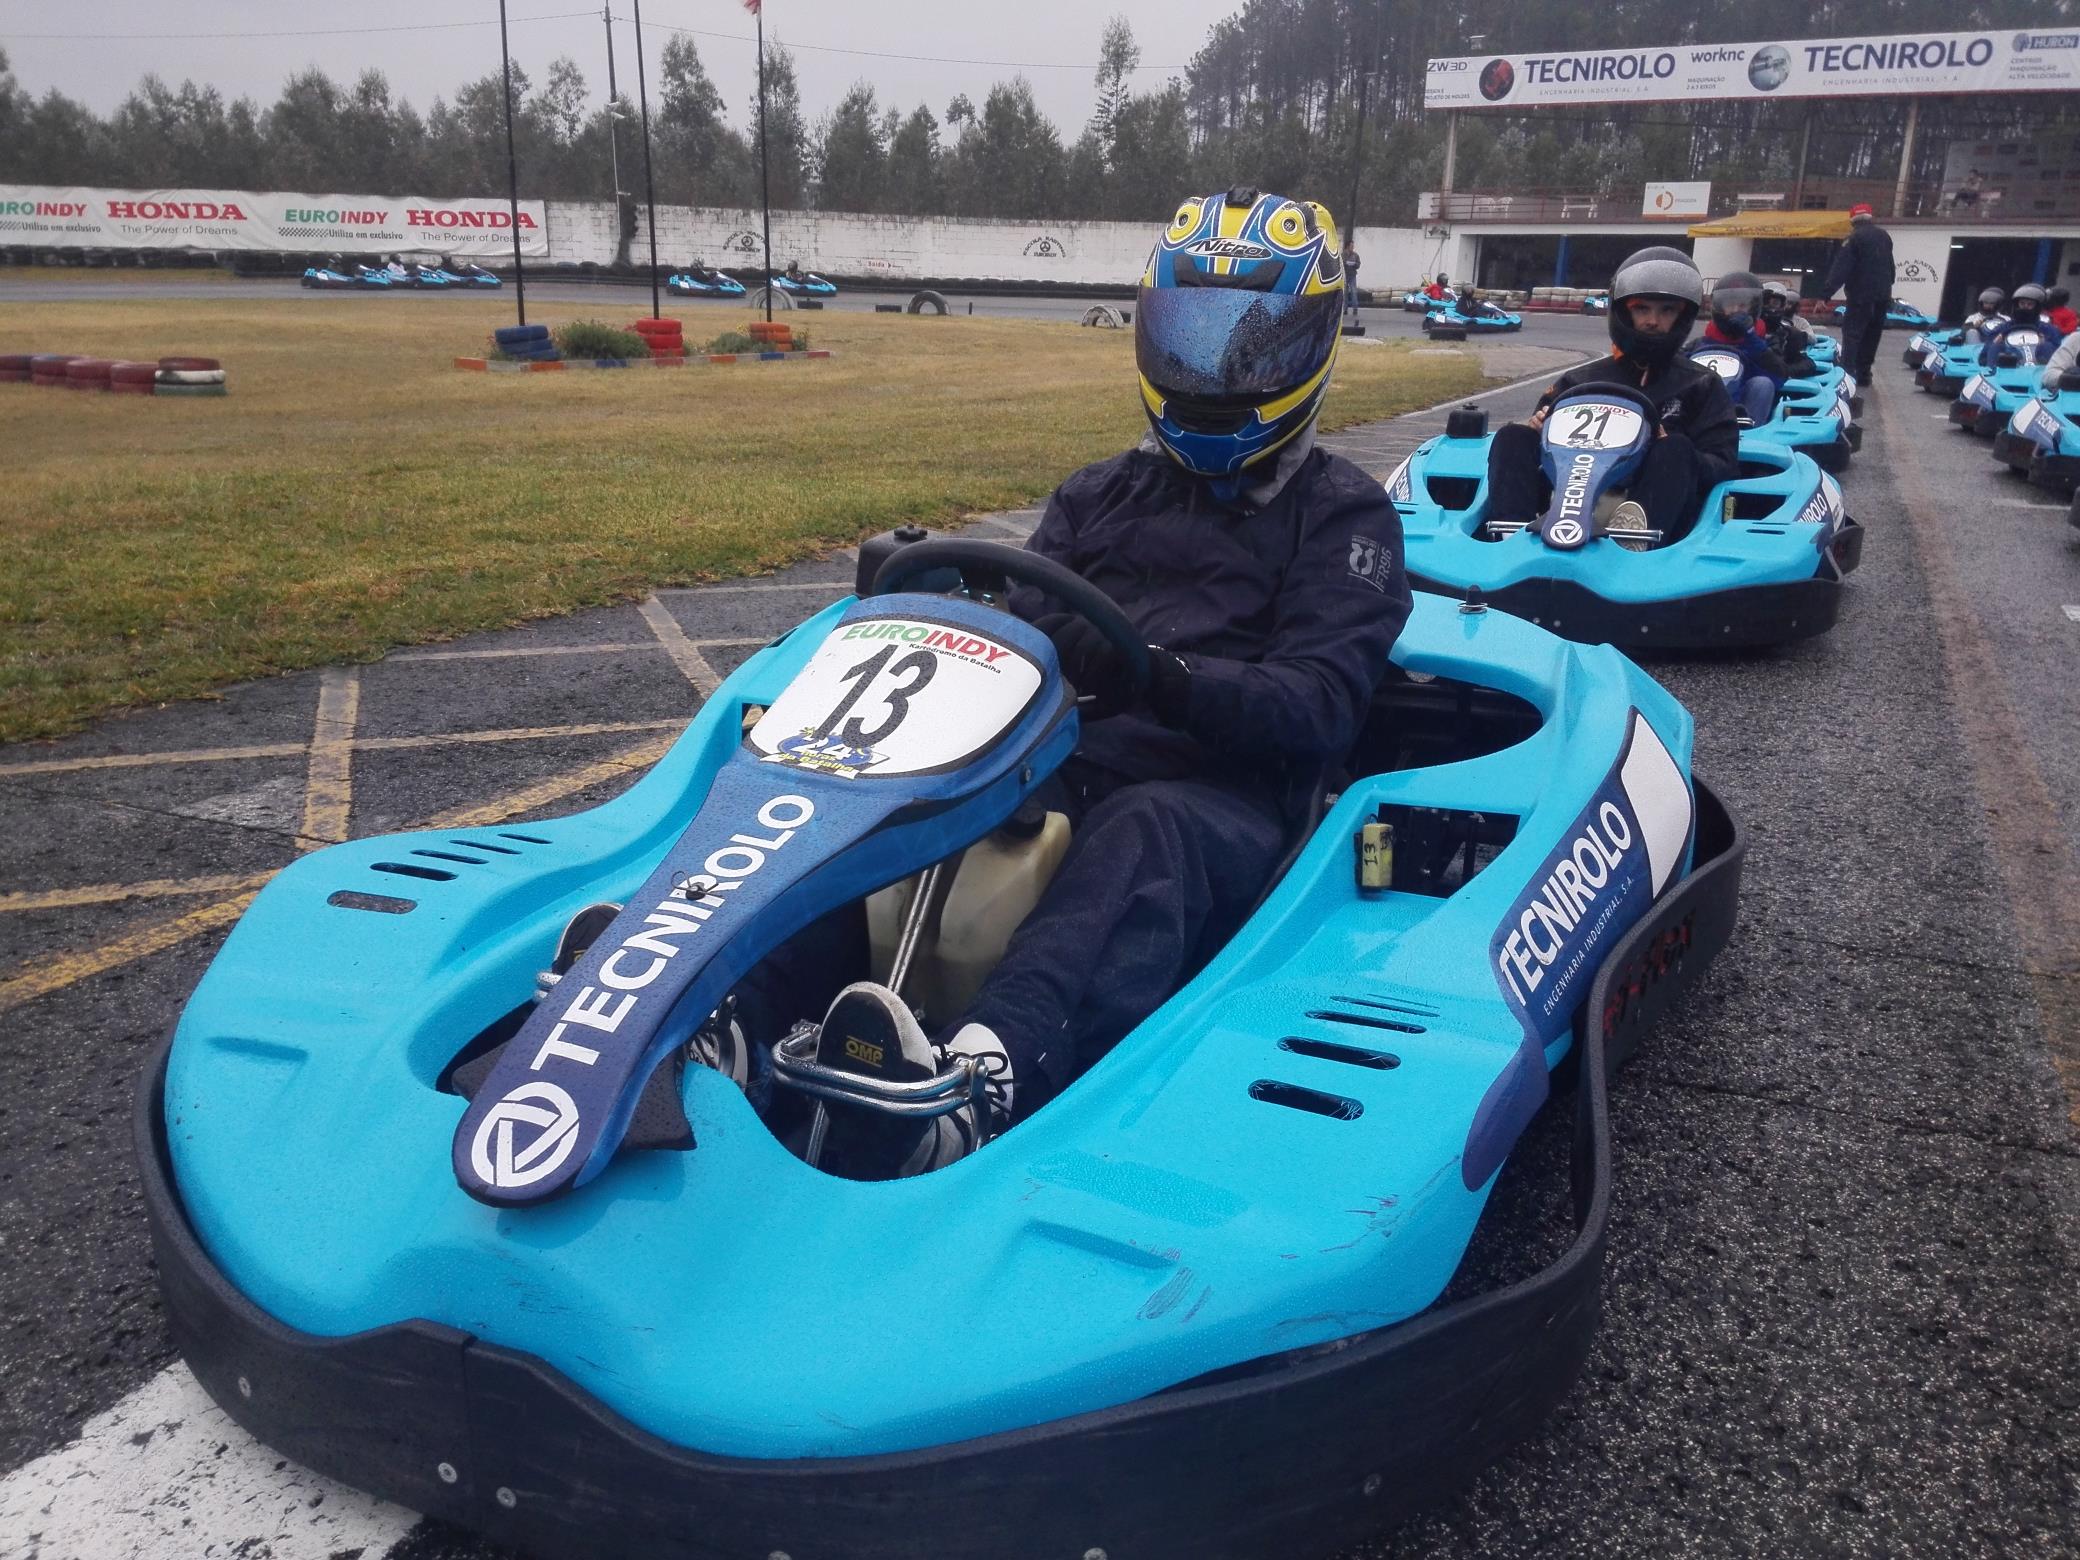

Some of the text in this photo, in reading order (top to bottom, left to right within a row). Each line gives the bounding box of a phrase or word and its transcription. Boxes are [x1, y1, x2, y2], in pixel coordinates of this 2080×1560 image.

[1691, 47, 1745, 62] worknc
[1804, 38, 1993, 72] TECNIROLO
[1524, 53, 1676, 84] TECNIROLO
[0, 201, 247, 220] ROINDY HONDA
[285, 208, 538, 228] EUROINDY HONDA
[22, 222, 49, 231] Utiliza
[66, 222, 101, 233] exclusivo
[121, 224, 238, 236] The Power of Dreams
[328, 226, 403, 240] Utiliza em exclusivo
[421, 231, 442, 241] The
[444, 232, 476, 243] Power
[478, 233, 489, 243] of
[1195, 239, 1263, 255] Nitro
[1707, 359, 1719, 373] 6
[1563, 404, 1630, 416] EUROINDY
[1568, 409, 1611, 441] 21
[1560, 454, 1595, 519] TECNIROLO
[842, 623, 1012, 664] EUROINDY
[958, 655, 969, 663] da
[969, 657, 1001, 675] Batalha
[811, 643, 938, 749] 13
[799, 755, 855, 772] Batalha
[1363, 842, 1379, 866] 13
[1500, 801, 1631, 1007] TECNIROLO
[530, 794, 815, 1071] TECNIROLO
[1543, 874, 1635, 1017] ENGENHARIA INDUSTRIAL, S.A.
[844, 1038, 884, 1065] OMP
